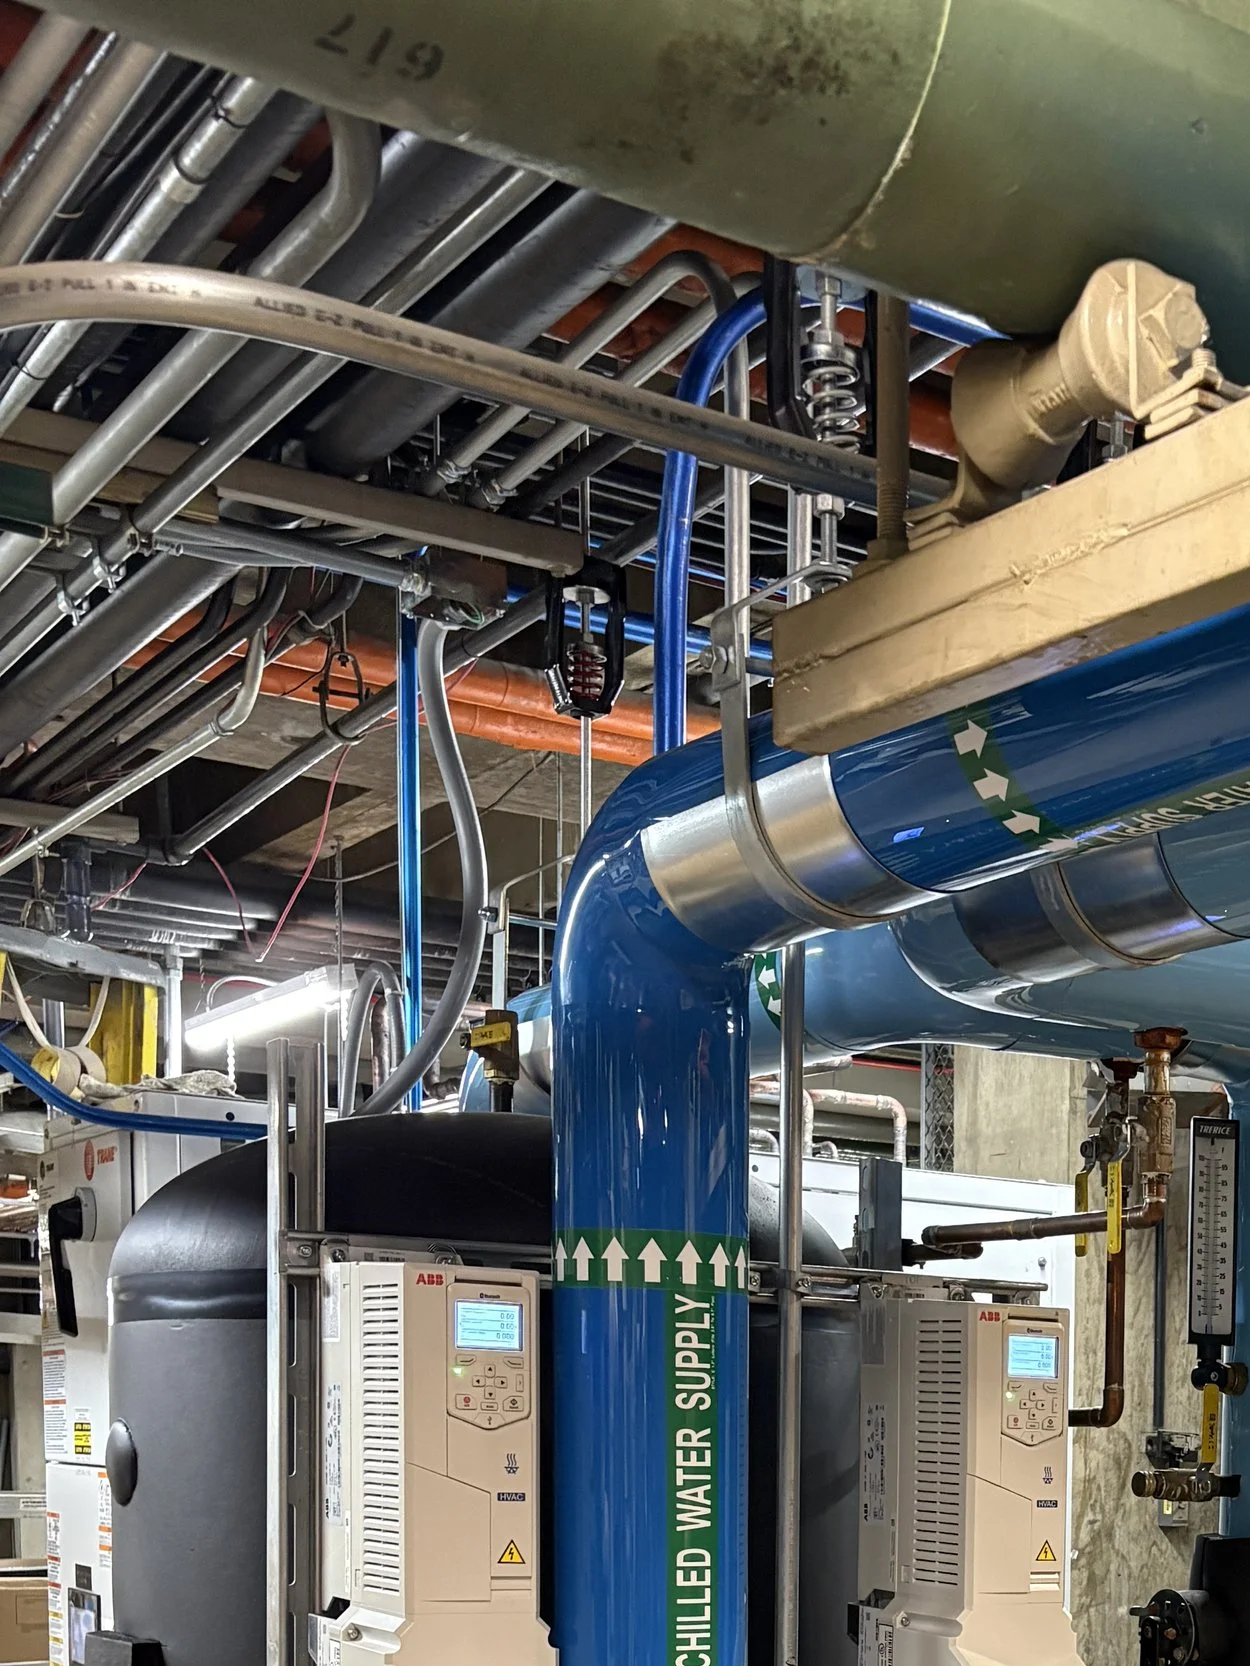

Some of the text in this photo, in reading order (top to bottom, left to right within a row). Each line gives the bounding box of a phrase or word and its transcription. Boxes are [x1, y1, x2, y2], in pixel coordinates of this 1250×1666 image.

[1200, 1125, 1231, 1135] TRERICE
[416, 1273, 444, 1286] ABB
[979, 1311, 1001, 1322] ABB
[674, 1293, 712, 1411] SUPPLY
[675, 1427, 712, 1532] WATER
[500, 1492, 525, 1501] HVAC
[1038, 1500, 1057, 1508] HVAC
